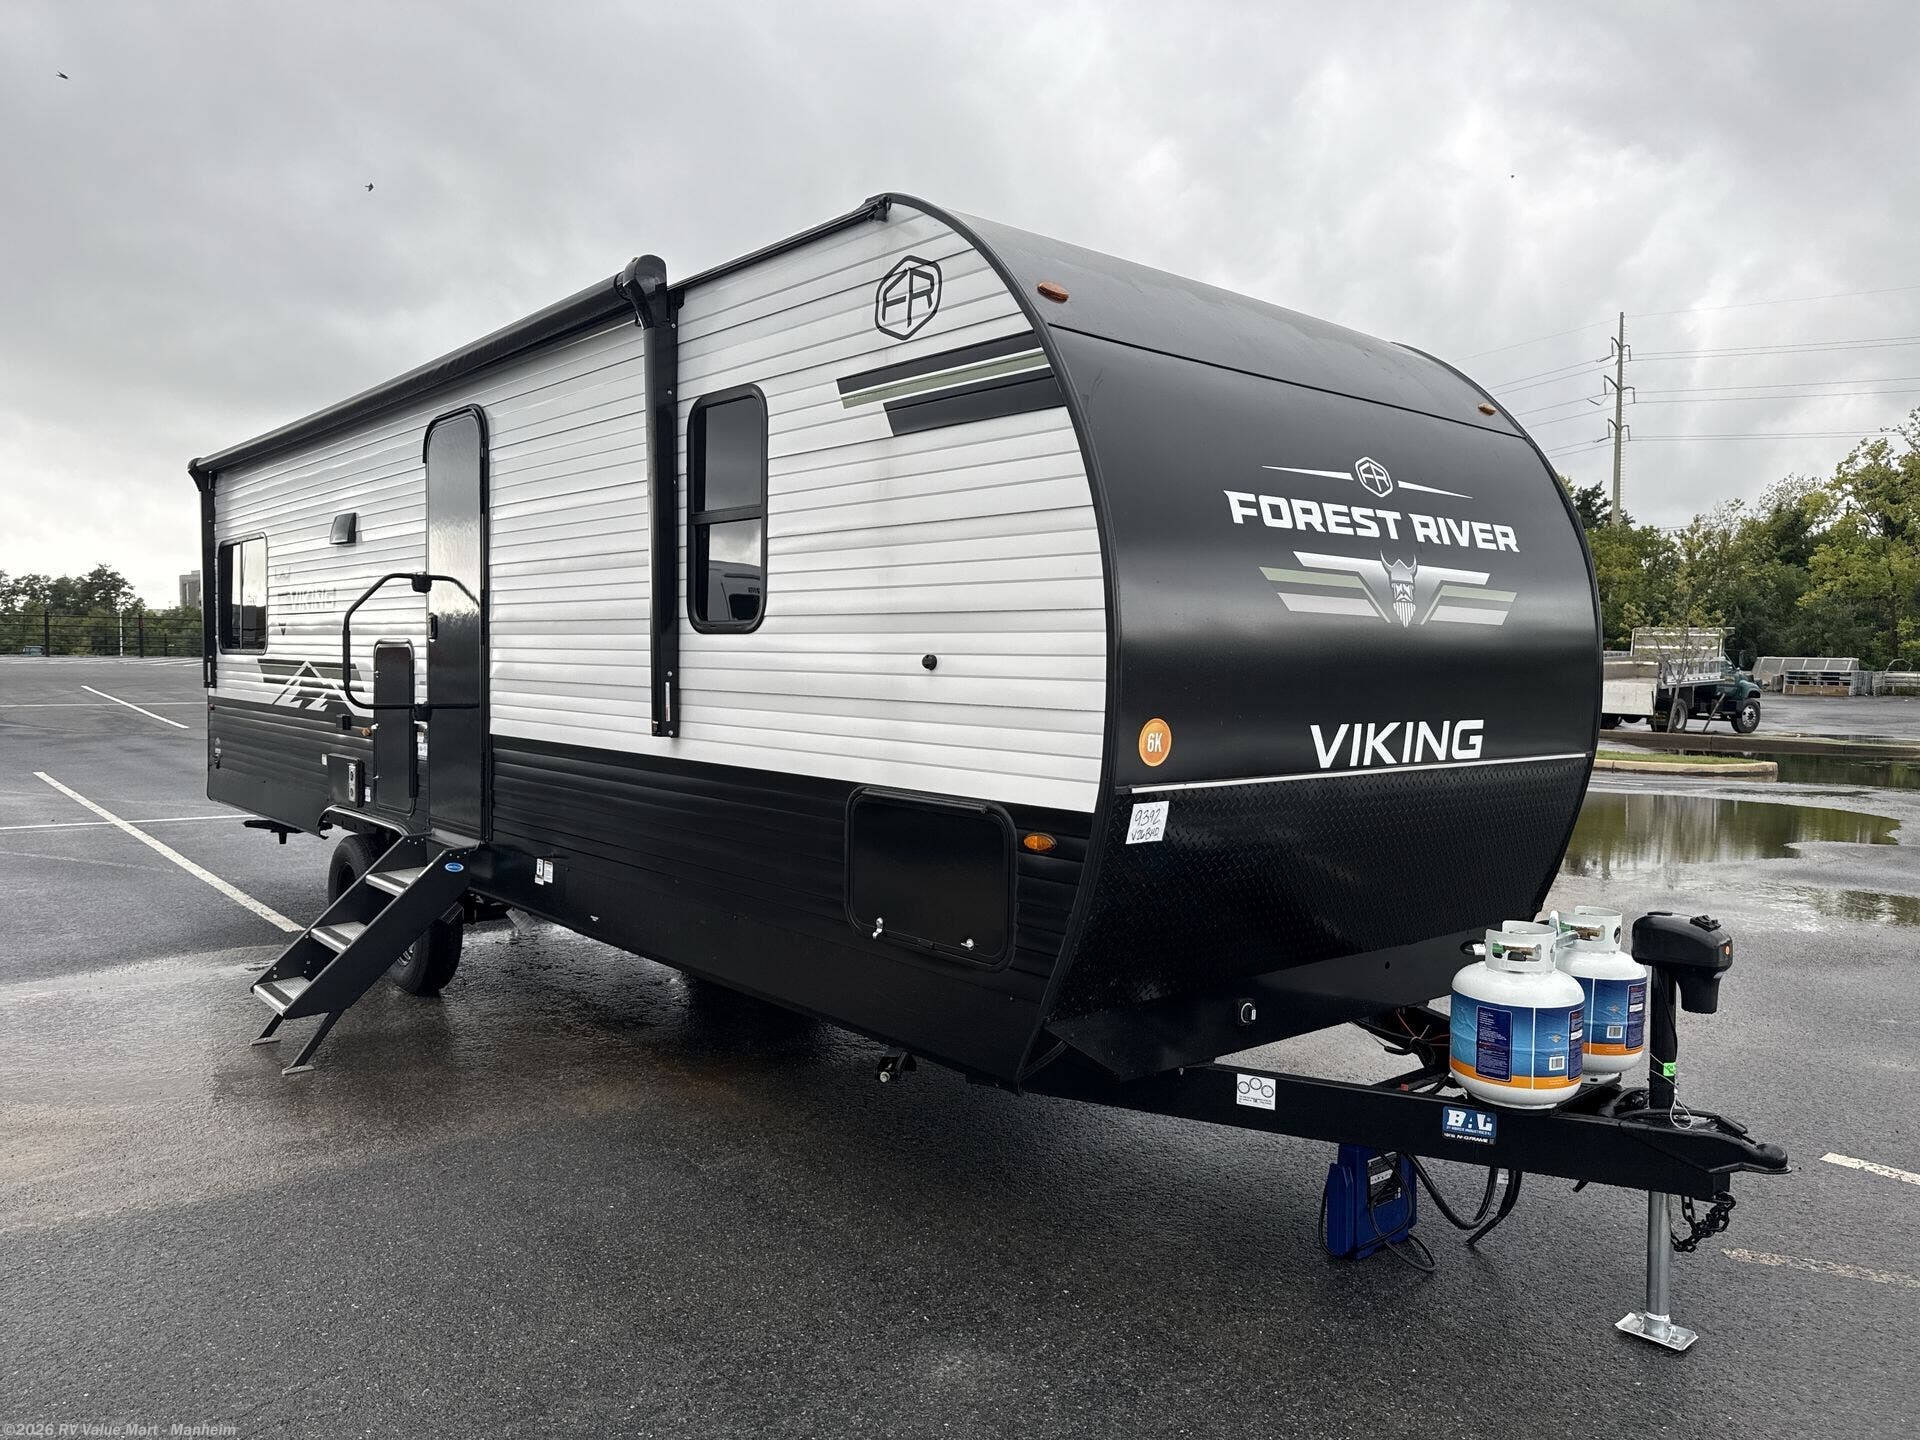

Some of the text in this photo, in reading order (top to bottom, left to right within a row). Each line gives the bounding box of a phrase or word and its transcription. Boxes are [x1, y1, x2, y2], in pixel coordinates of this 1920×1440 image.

[1223, 490, 1521, 552] FOREST RIVER
[1147, 732, 1163, 752] 6K
[1310, 719, 1485, 768] VIKING
[1135, 809, 1161, 826] 9392
